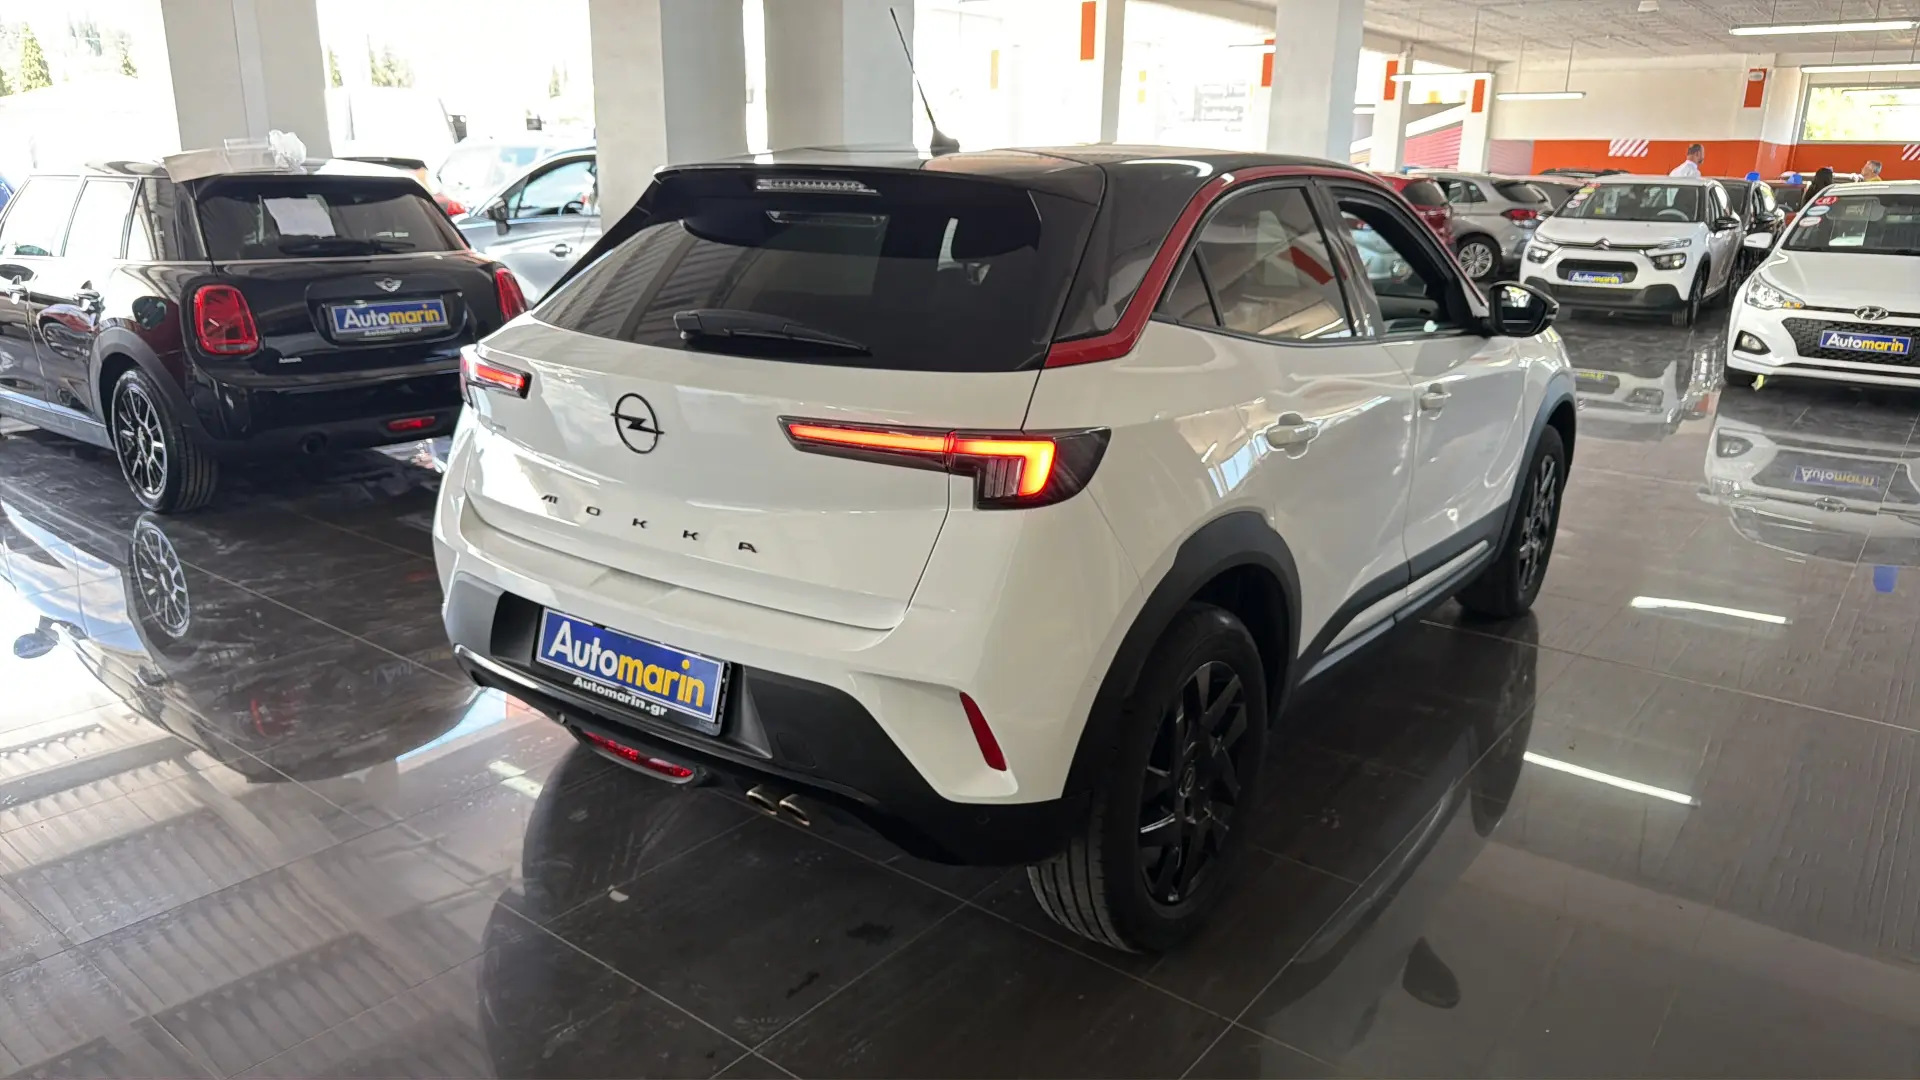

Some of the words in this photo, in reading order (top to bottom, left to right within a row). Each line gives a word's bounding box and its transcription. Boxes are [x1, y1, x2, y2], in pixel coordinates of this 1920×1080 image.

[1572, 272, 1619, 284] Automarin
[343, 303, 440, 328] Automarin
[1826, 332, 1904, 353] Automarin
[541, 494, 757, 553] MOKKA
[548, 620, 706, 707] Automarin
[573, 676, 667, 717] Automarin.gr
